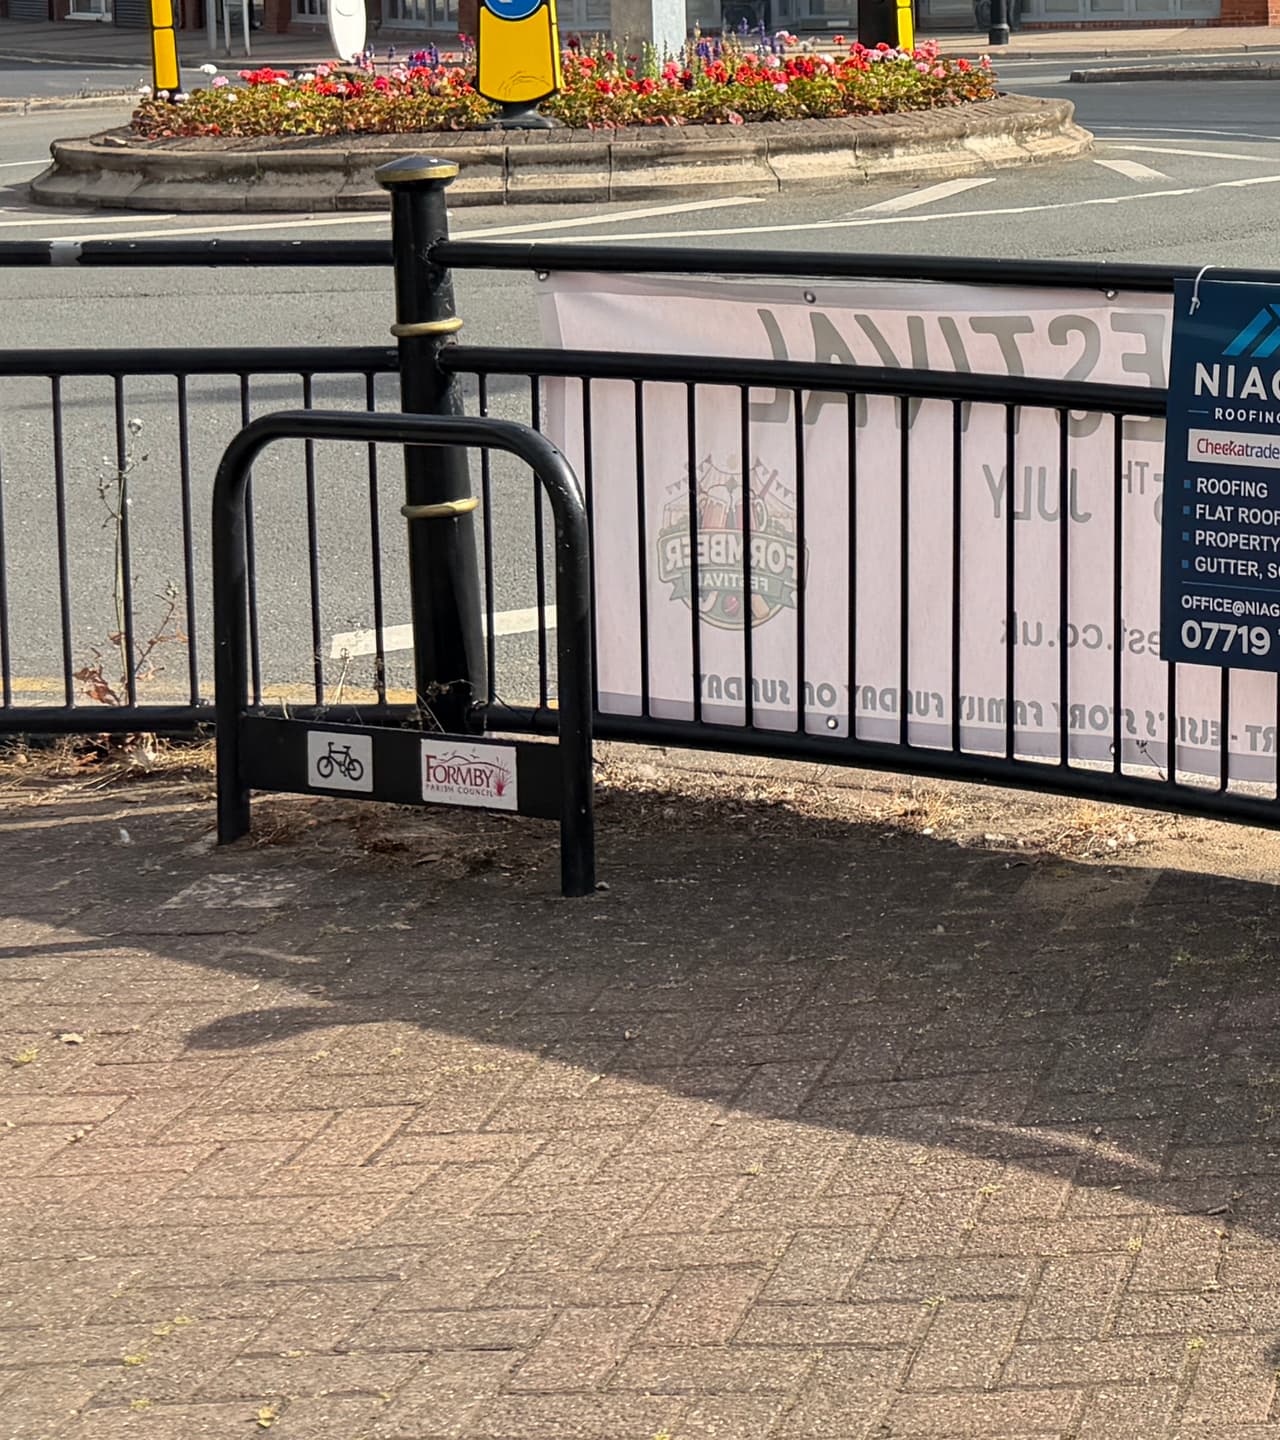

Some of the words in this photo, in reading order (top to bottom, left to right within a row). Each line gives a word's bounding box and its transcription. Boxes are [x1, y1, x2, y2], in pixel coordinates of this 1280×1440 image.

[1196, 437, 1280, 461] Checkatrade
[1196, 478, 1269, 500] ROOFING
[1196, 504, 1234, 523] FLAT
[1195, 530, 1280, 553] PROPERTY
[1194, 556, 1263, 580] GUTTER,
[1181, 619, 1271, 656] 07719
[425, 754, 494, 788] FORMBY
[426, 783, 454, 793] PARISH
[457, 787, 494, 797] COUNCIL
